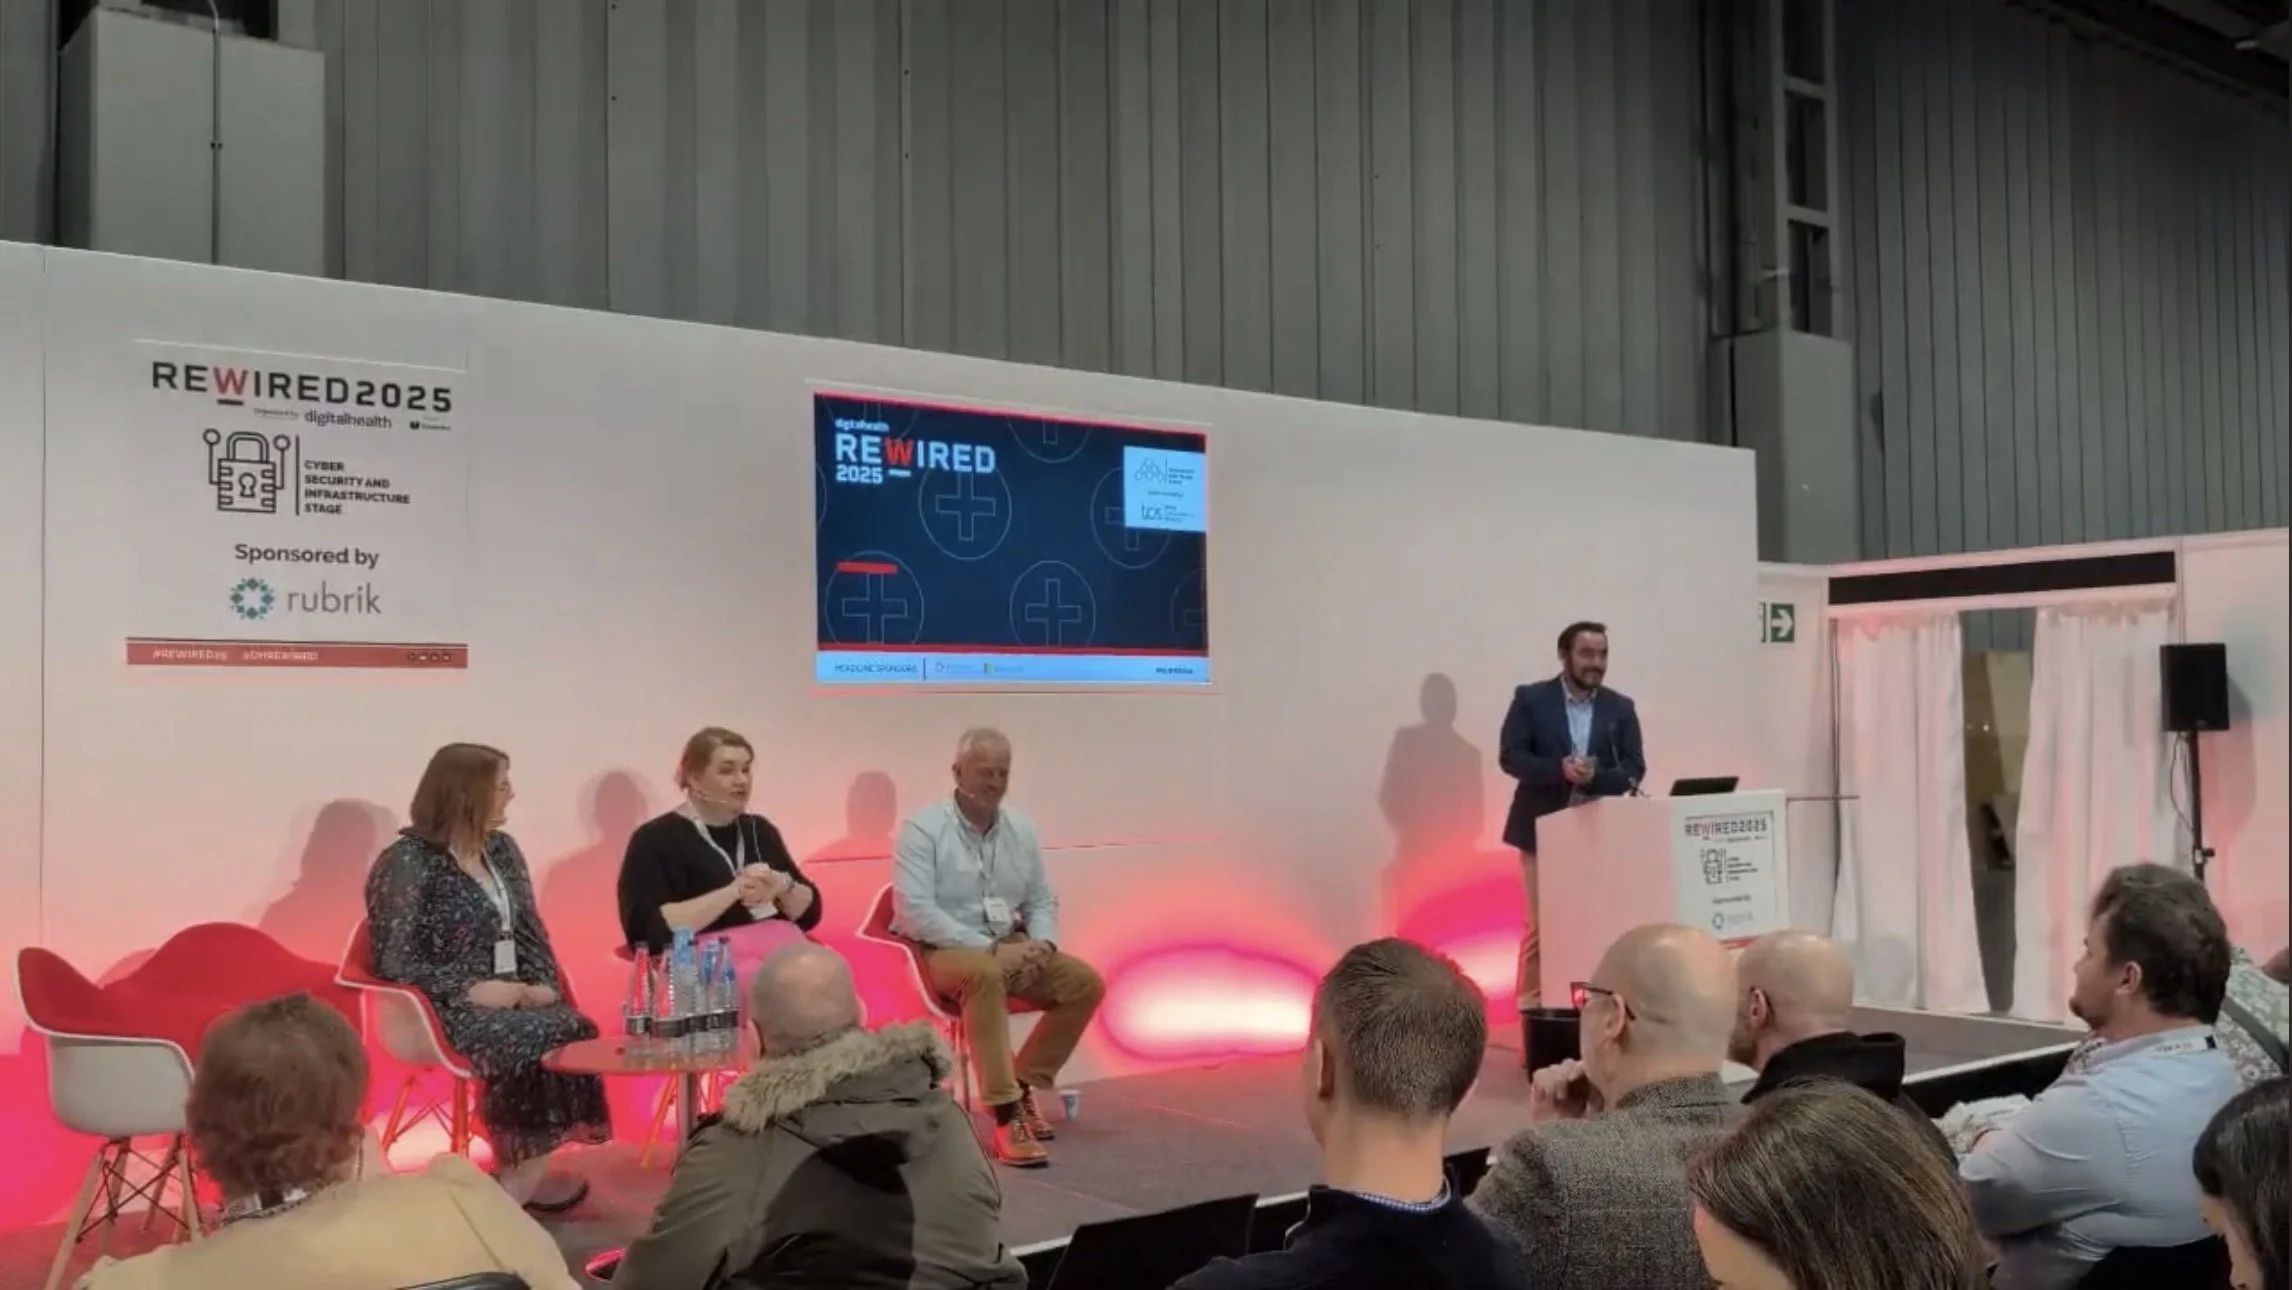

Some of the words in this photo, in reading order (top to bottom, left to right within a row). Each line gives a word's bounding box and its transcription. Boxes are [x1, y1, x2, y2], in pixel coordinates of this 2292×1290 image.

[152, 361, 453, 413] REWIRED2025
[304, 409, 393, 429] digitalhealth
[835, 433, 996, 474] REWIRED
[304, 460, 345, 471] CYBER
[836, 464, 884, 484] 2025
[304, 475, 364, 488] SECURITY
[365, 478, 391, 489] AND
[304, 490, 411, 505] INFRASTRUCTURE
[304, 504, 344, 515] STAGE
[234, 543, 349, 565] Sponsored
[355, 548, 380, 570] by
[287, 580, 382, 614] rubrik
